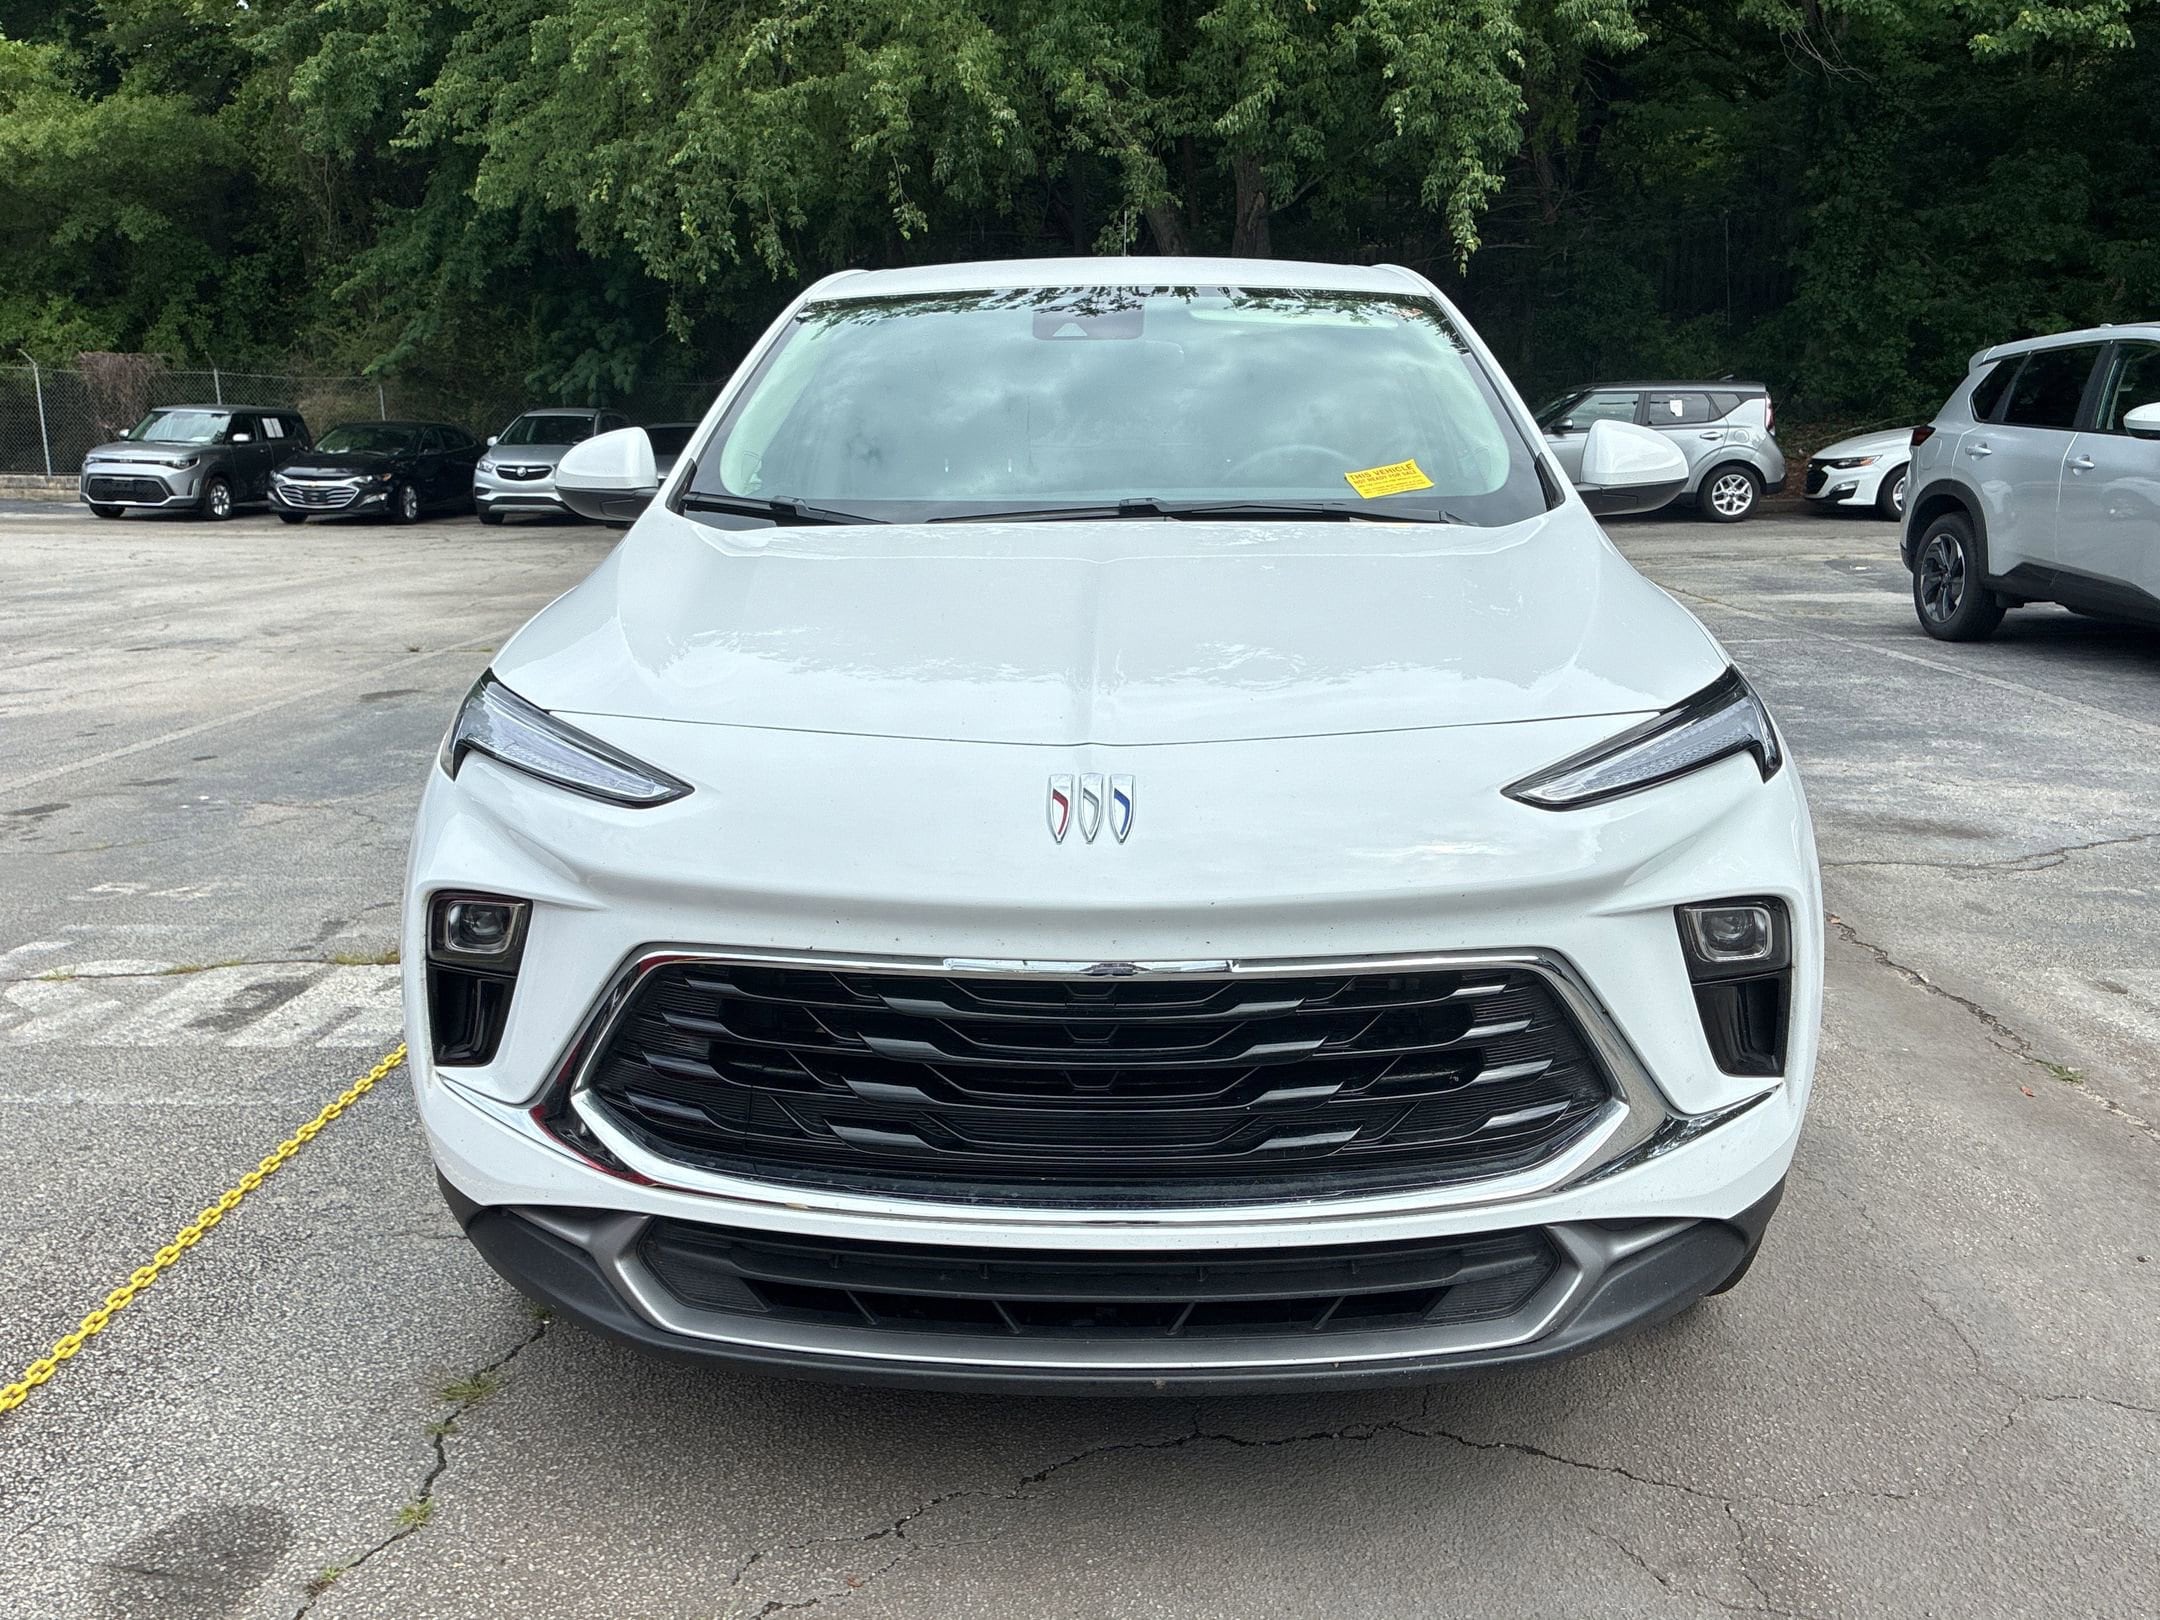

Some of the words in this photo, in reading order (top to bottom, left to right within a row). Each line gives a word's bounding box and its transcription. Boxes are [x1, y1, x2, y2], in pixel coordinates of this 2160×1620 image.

[1350, 472, 1372, 481] THIS
[1373, 463, 1414, 476] VEHICLE
[1353, 477, 1366, 485] NOT
[1401, 469, 1417, 477] SALE
